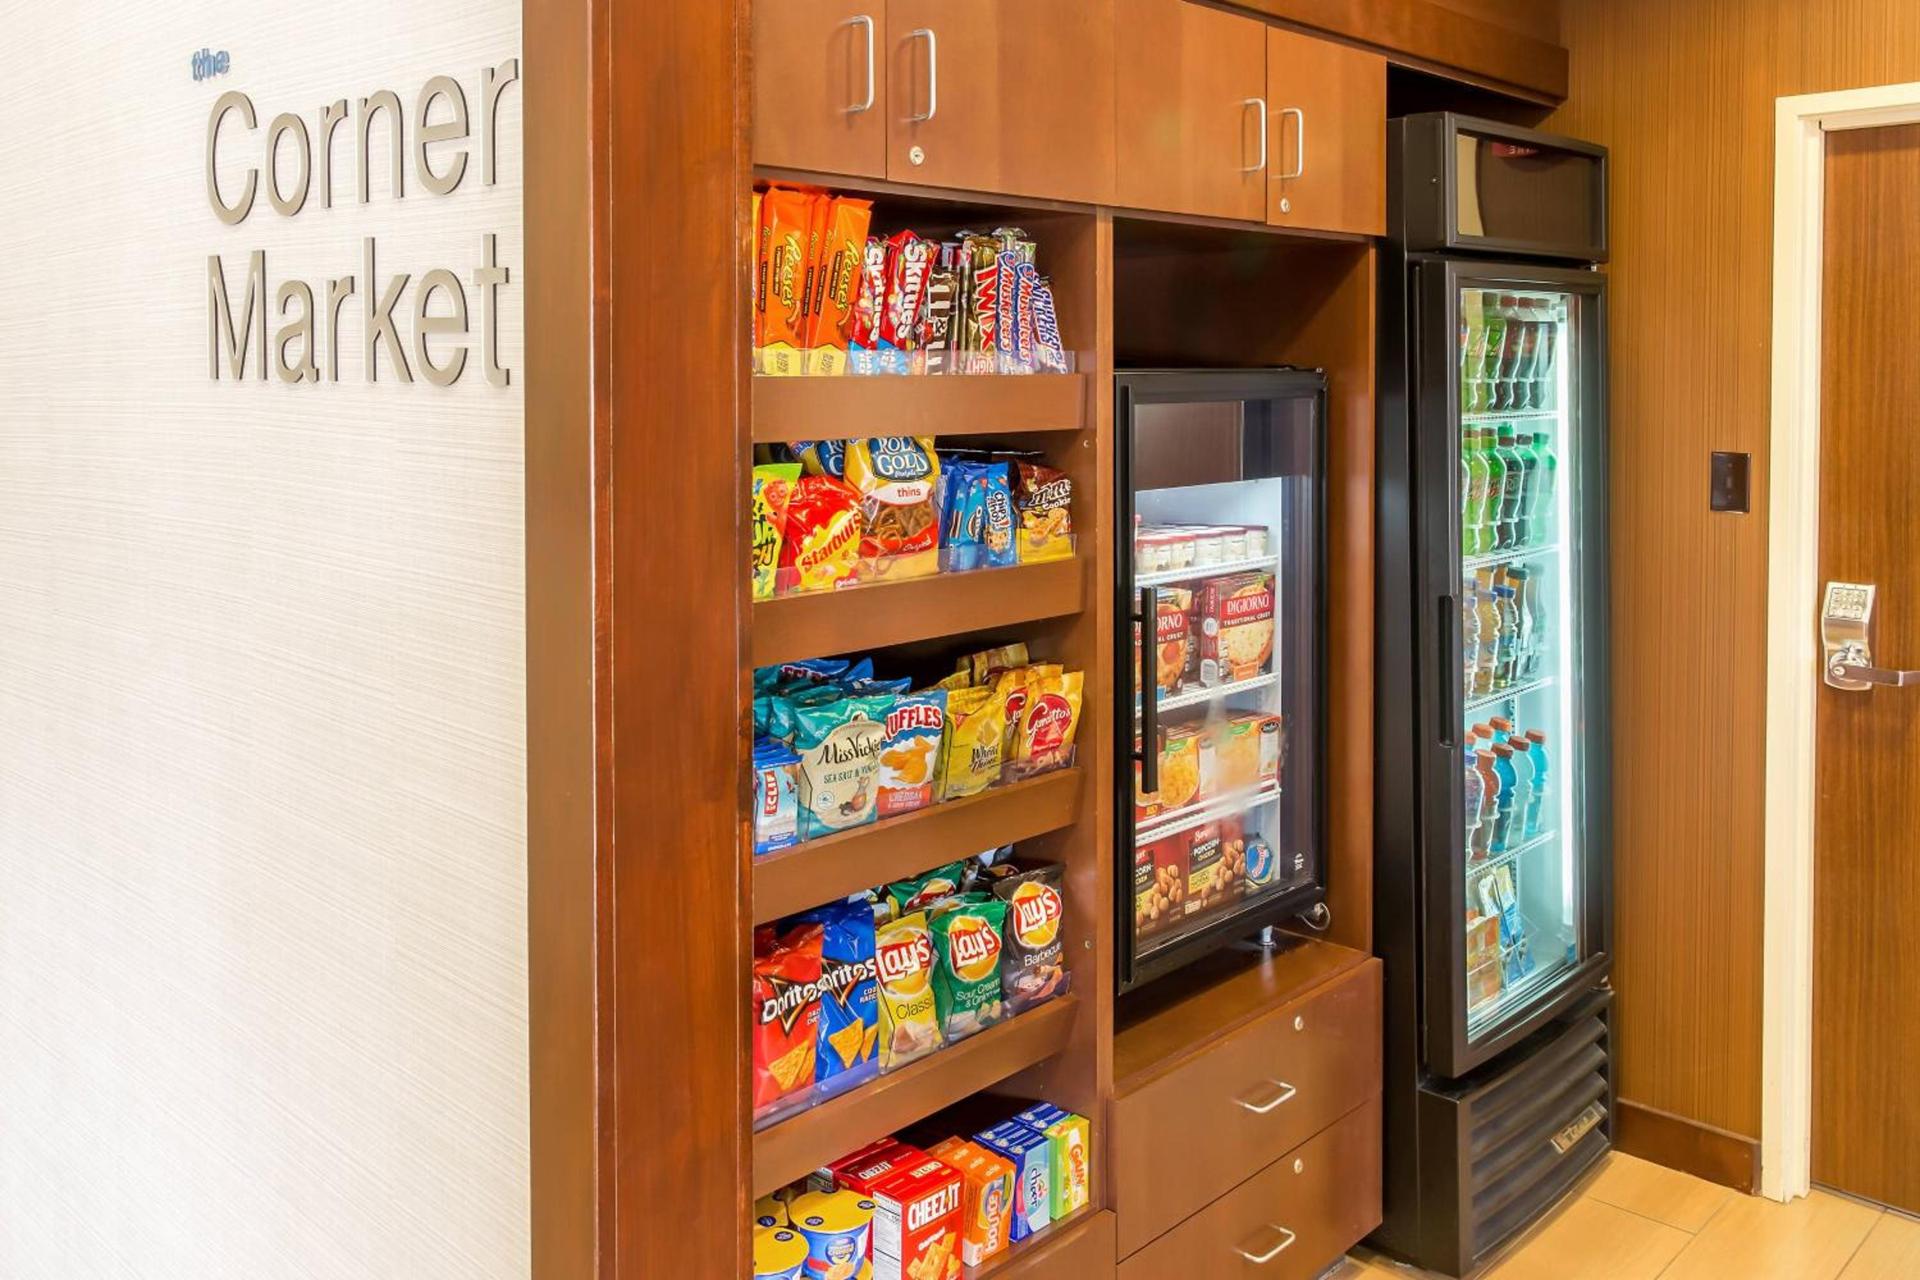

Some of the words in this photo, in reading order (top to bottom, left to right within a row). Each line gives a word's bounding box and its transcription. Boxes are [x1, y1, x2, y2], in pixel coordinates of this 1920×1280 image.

[192, 48, 230, 81] the
[206, 58, 519, 225] Corner
[207, 233, 510, 386] Market
[897, 243, 927, 339] Skittles
[877, 453, 929, 476] GOLD
[897, 487, 921, 498] thins
[801, 509, 862, 573] Starburs
[1227, 594, 1270, 615] DIGIORNO
[817, 742, 852, 765] Miss
[1018, 891, 1058, 932] Lay's
[877, 938, 931, 982] Lay's
[952, 928, 996, 967] Lay's
[1024, 942, 1061, 967] Barbecue
